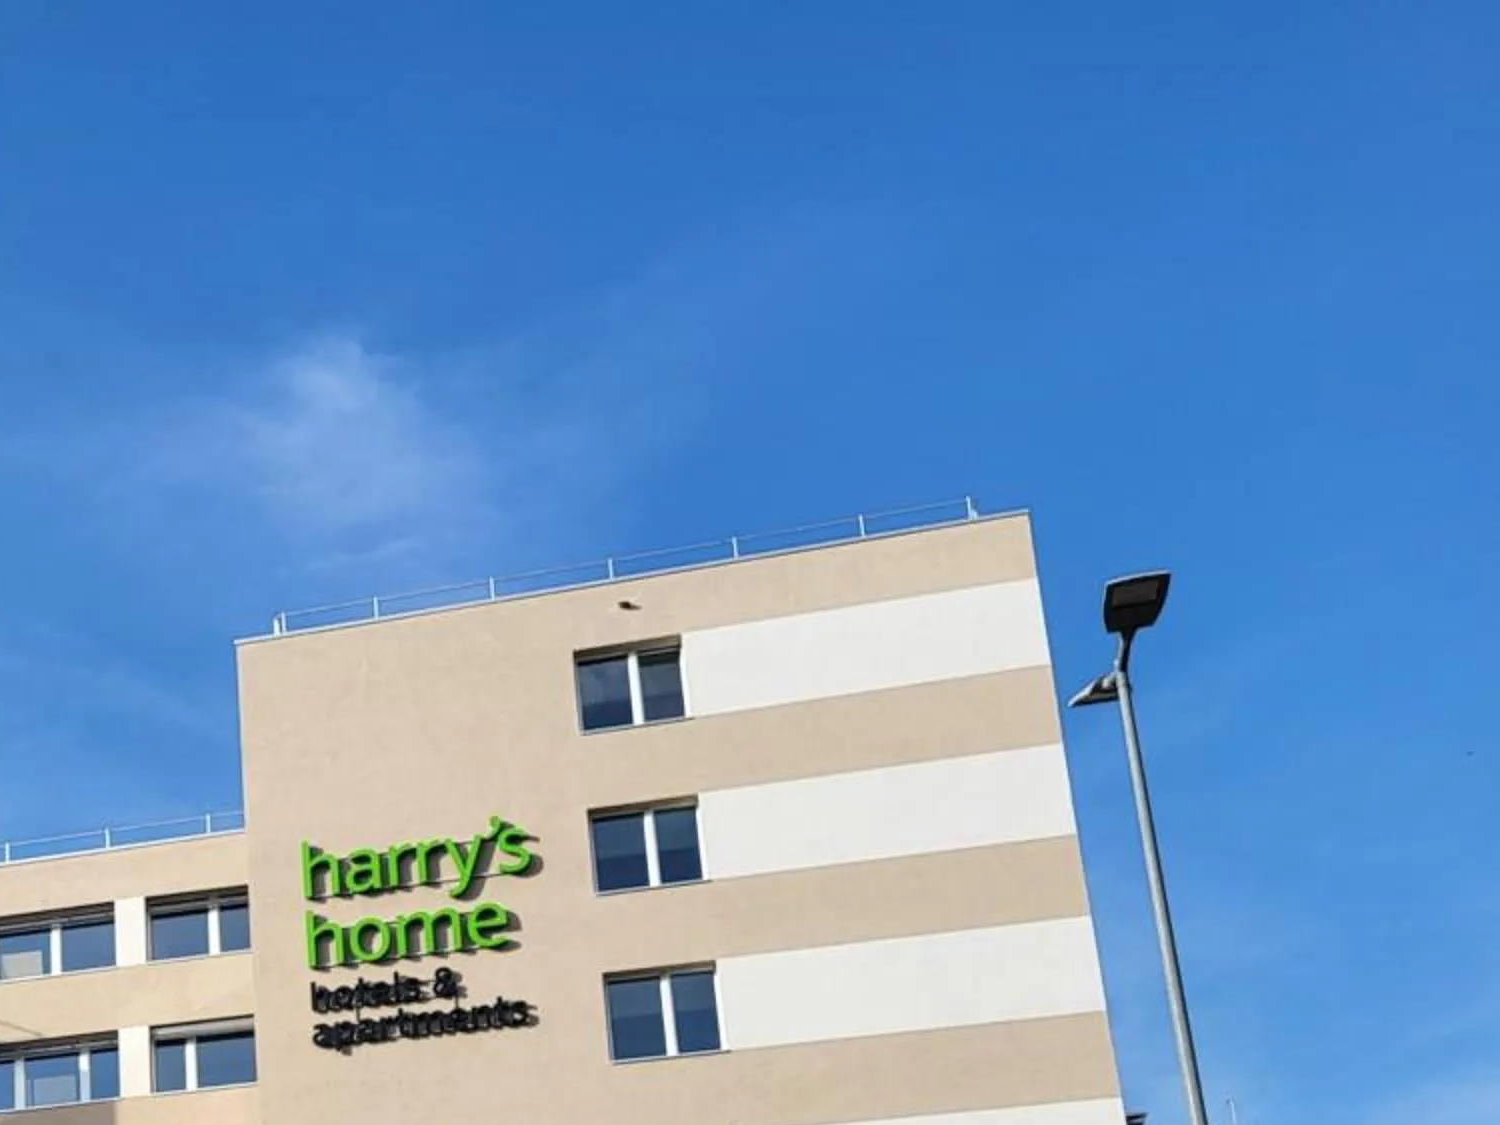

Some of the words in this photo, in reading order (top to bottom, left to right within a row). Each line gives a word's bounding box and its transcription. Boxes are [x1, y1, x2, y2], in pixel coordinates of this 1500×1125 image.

[301, 815, 534, 899] harry's
[305, 902, 510, 969] home
[310, 972, 421, 1014] hotels
[432, 967, 460, 997] &
[312, 996, 532, 1050] apartments
